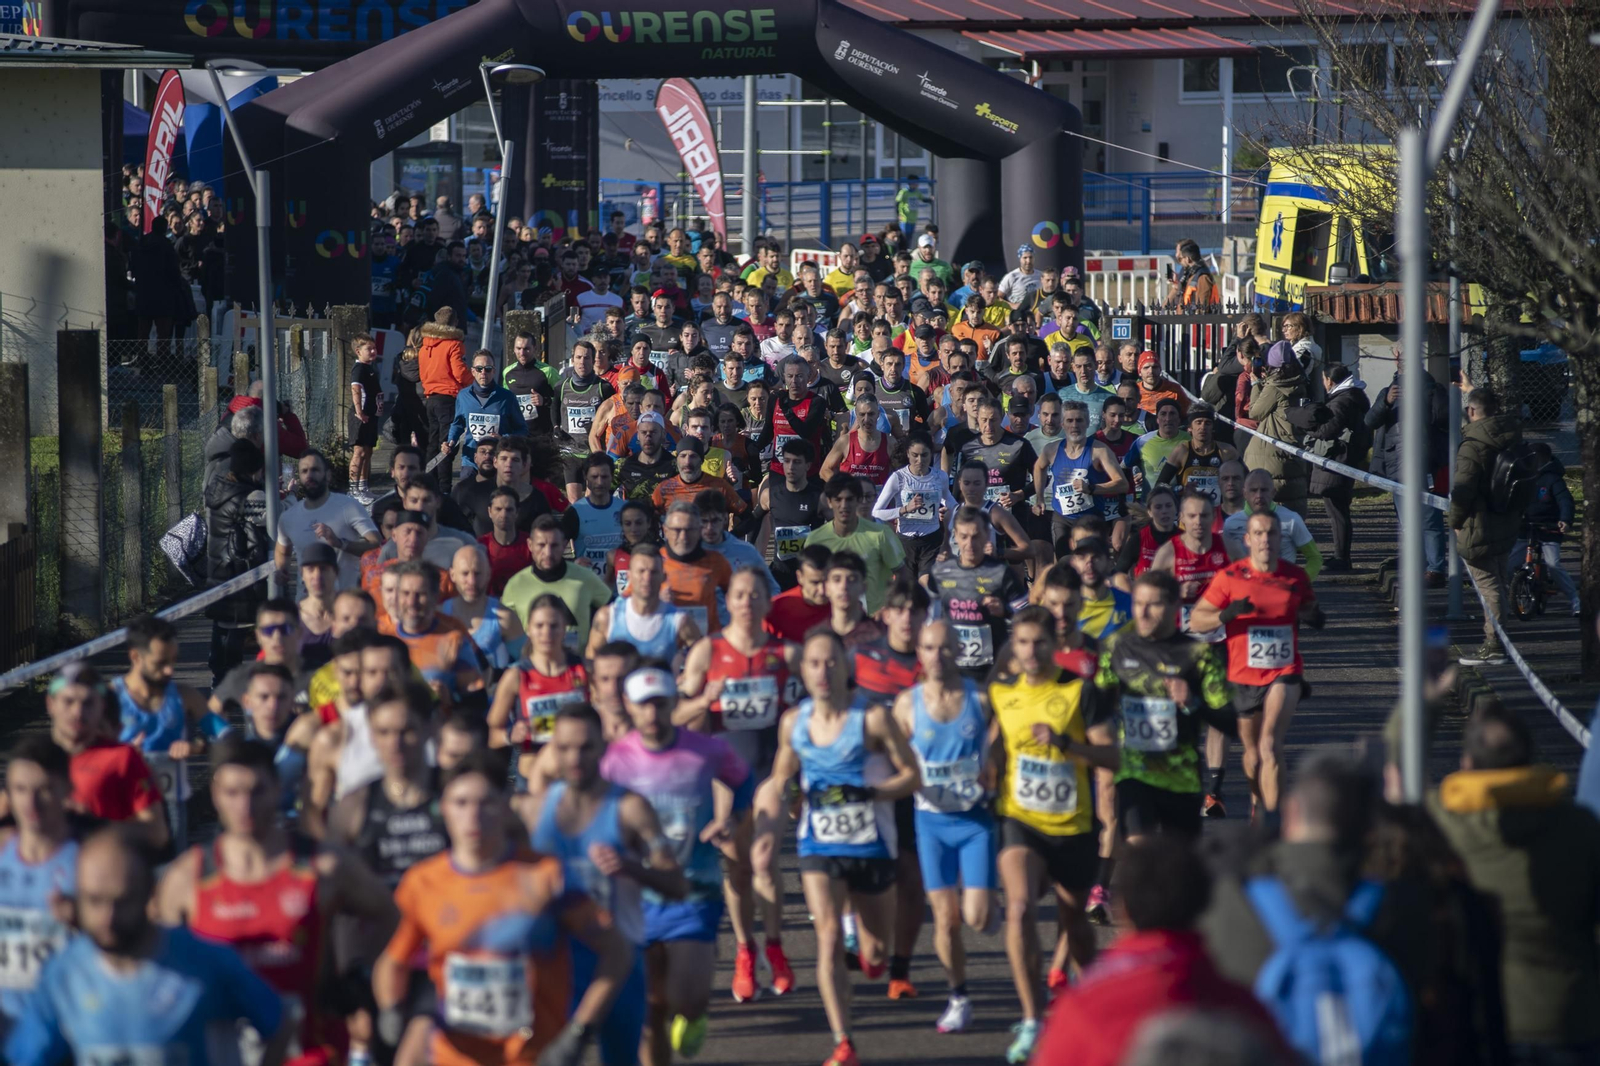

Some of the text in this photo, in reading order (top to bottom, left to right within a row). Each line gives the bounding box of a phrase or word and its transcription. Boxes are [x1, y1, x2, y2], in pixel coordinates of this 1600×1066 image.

[566, 9, 778, 43] OURENSE
[701, 46, 776, 60] NATURAL
[849, 48, 900, 75] DEPUTACIÓN
[847, 56, 884, 77] OURENSE
[720, 89, 744, 101] das
[757, 89, 782, 101] iñas
[922, 81, 948, 97] inorde
[985, 111, 1019, 132] DEPORTE
[143, 100, 184, 218] ABRIL
[1031, 220, 1081, 250] OU
[1116, 326, 1128, 337] 10
[470, 424, 496, 437] 234
[1058, 484, 1074, 496] XXII
[1064, 493, 1086, 508] 33
[950, 599, 979, 611] Café
[950, 609, 983, 622] Vivian
[1250, 642, 1292, 660] 245
[726, 699, 772, 720] 267
[1127, 719, 1172, 740] 303
[1018, 778, 1071, 801] 360
